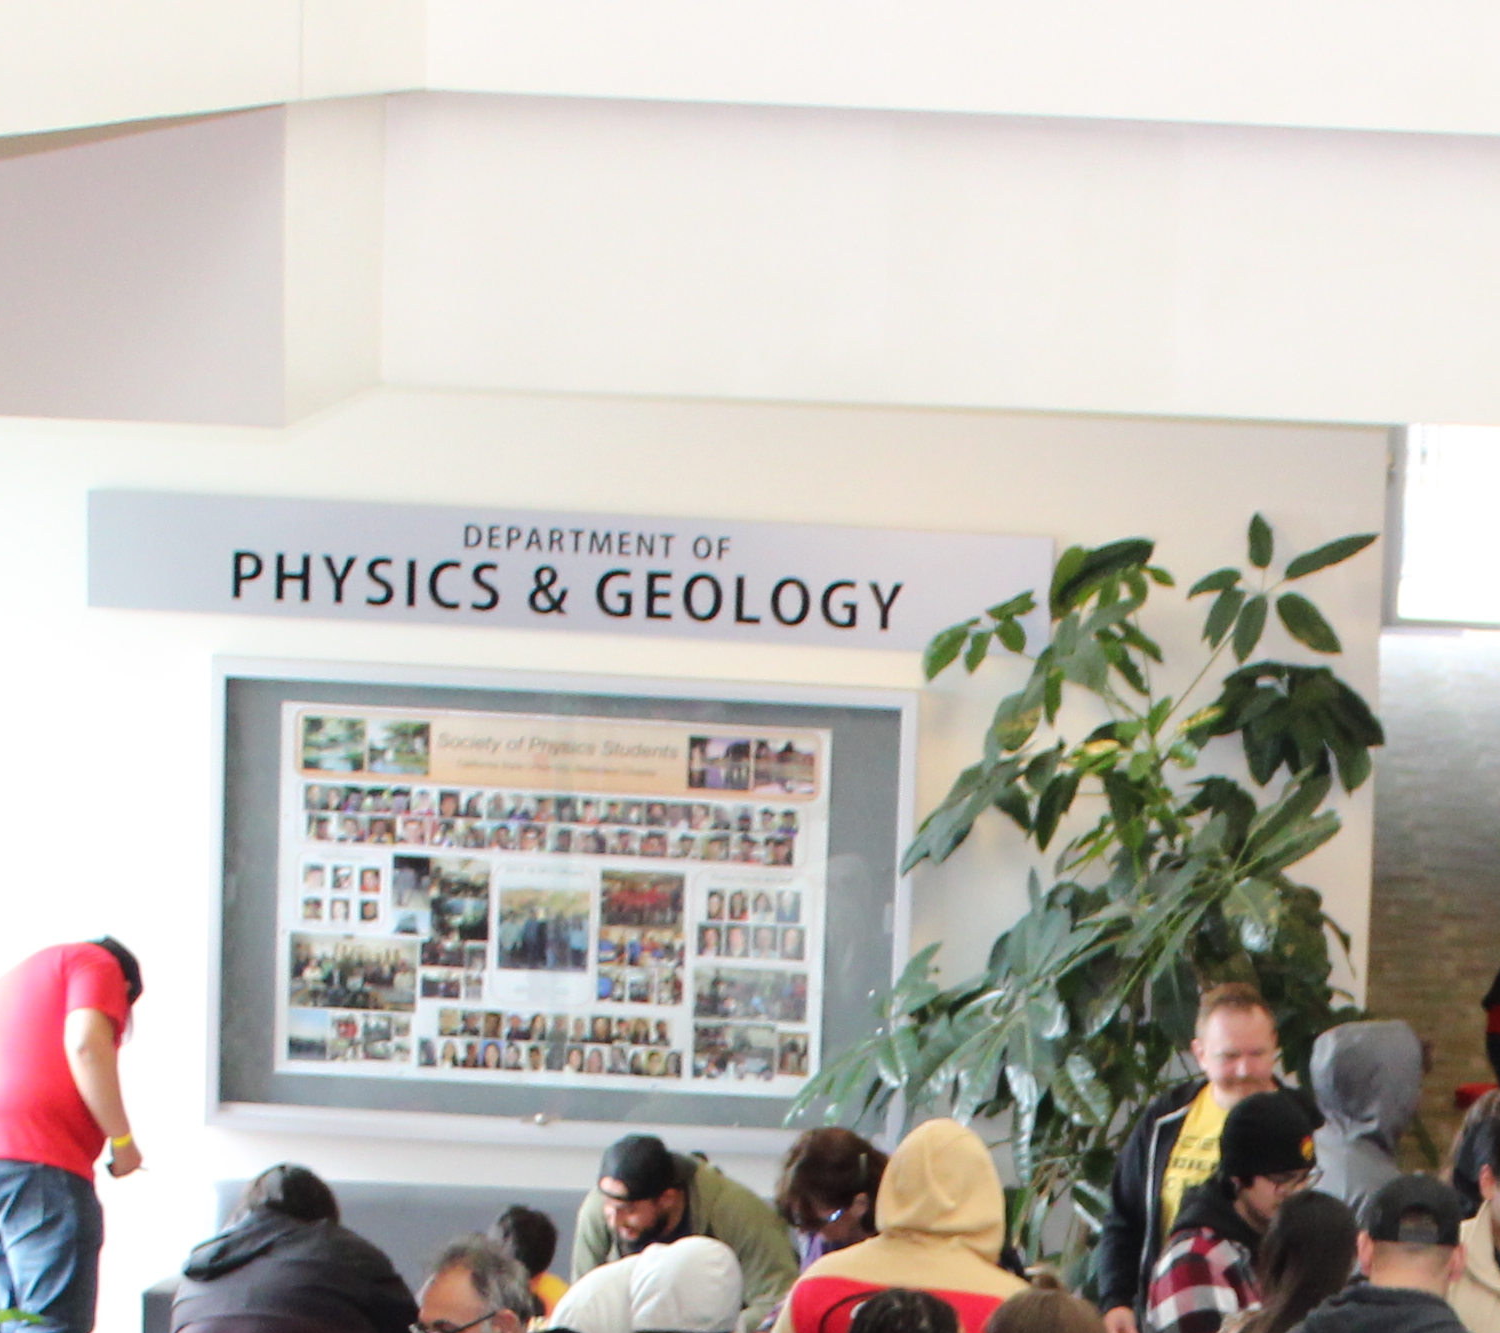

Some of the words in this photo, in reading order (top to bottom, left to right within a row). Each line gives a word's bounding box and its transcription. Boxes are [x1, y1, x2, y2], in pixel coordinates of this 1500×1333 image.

[463, 523, 676, 559] DEPARTMENT
[692, 534, 731, 561] OF
[231, 549, 501, 613] PHYSICS
[527, 565, 569, 616] &
[595, 568, 905, 631] GEOLOGY
